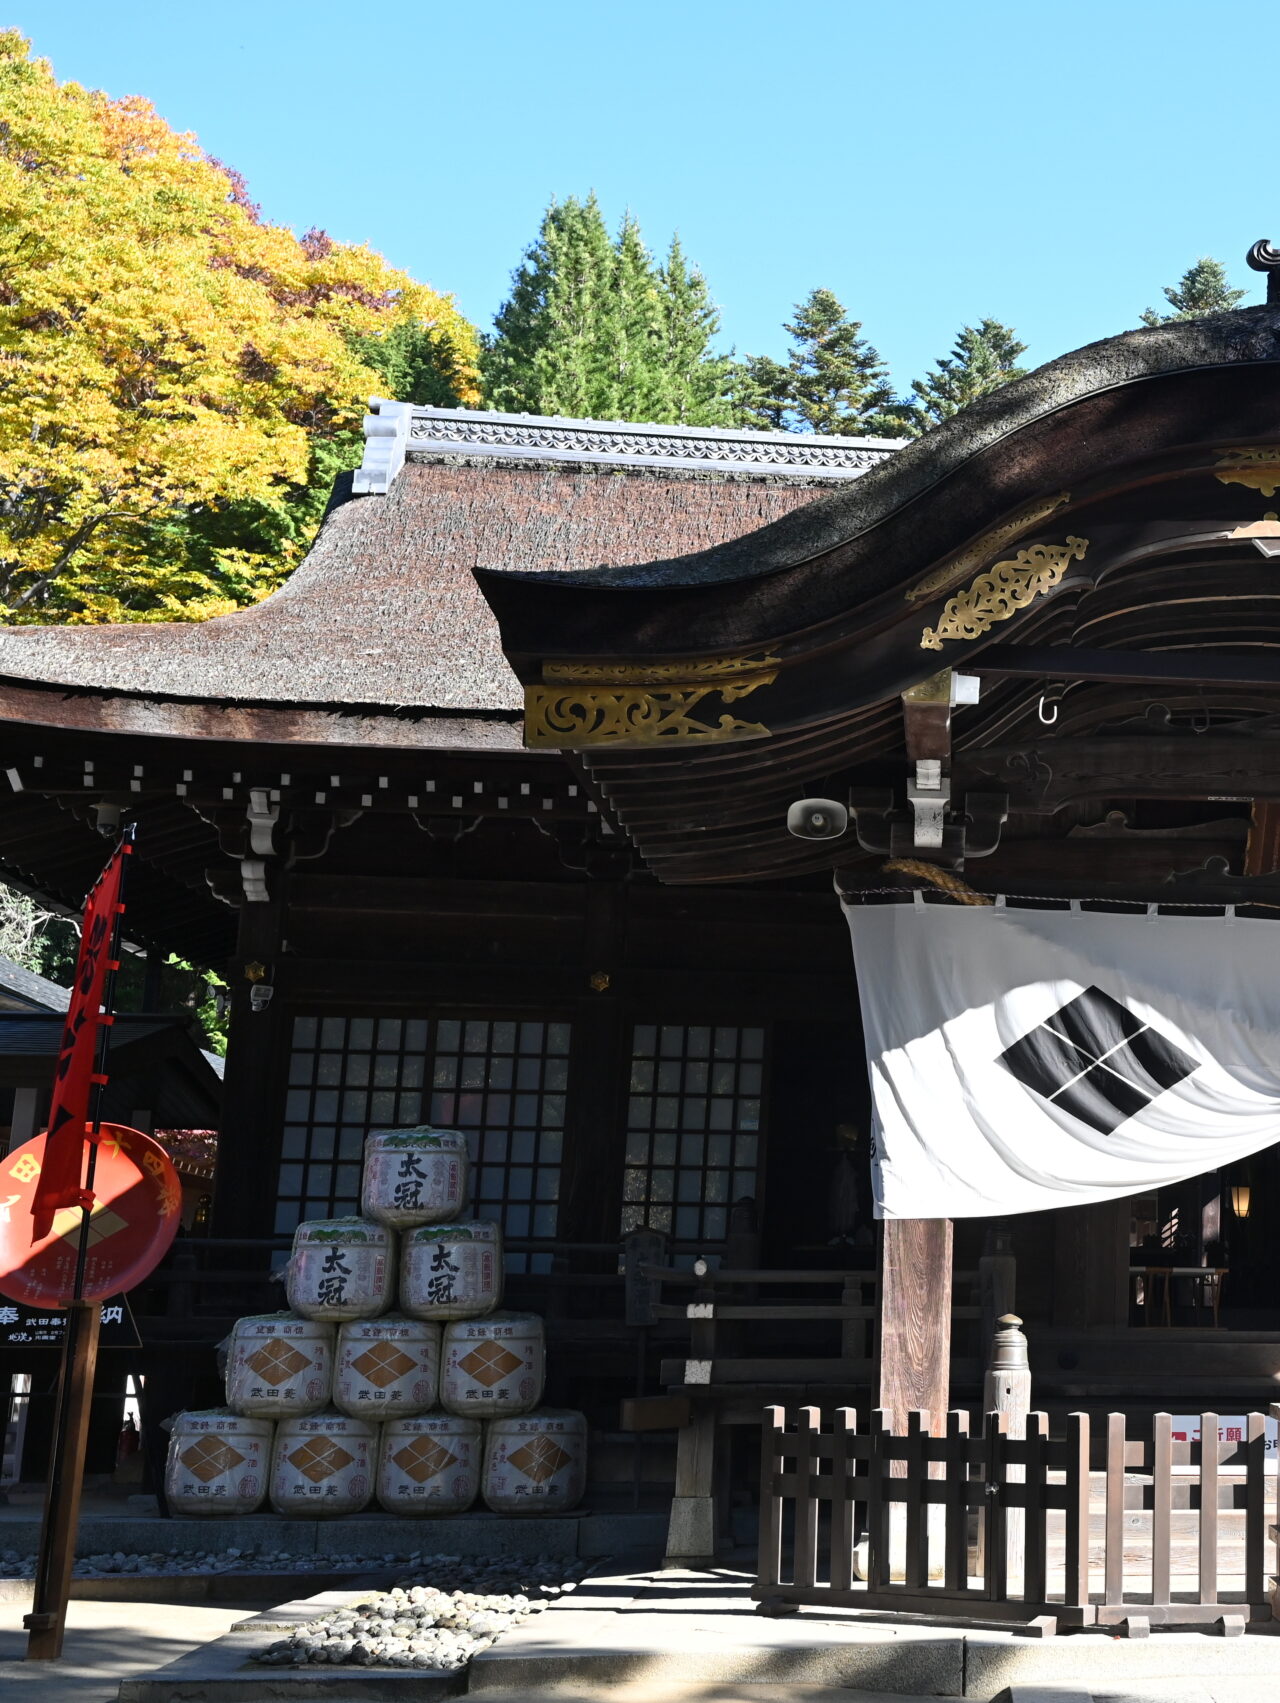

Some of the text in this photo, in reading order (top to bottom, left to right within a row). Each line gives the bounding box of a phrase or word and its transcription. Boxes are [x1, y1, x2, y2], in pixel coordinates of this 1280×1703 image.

[393, 1152, 429, 1211] 太冠
[317, 1246, 353, 1307] 太冠
[427, 1243, 461, 1305] 太冠
[25, 1318, 67, 1326] 武田奉
[250, 1387, 297, 1399] 武田菱
[358, 1389, 403, 1401] 武田菱
[465, 1388, 510, 1400] 武田菱
[183, 1484, 227, 1496] 武田菱
[293, 1485, 338, 1496] 武田菱
[397, 1484, 442, 1497] 武田菱
[515, 1484, 560, 1496] 武田菱
